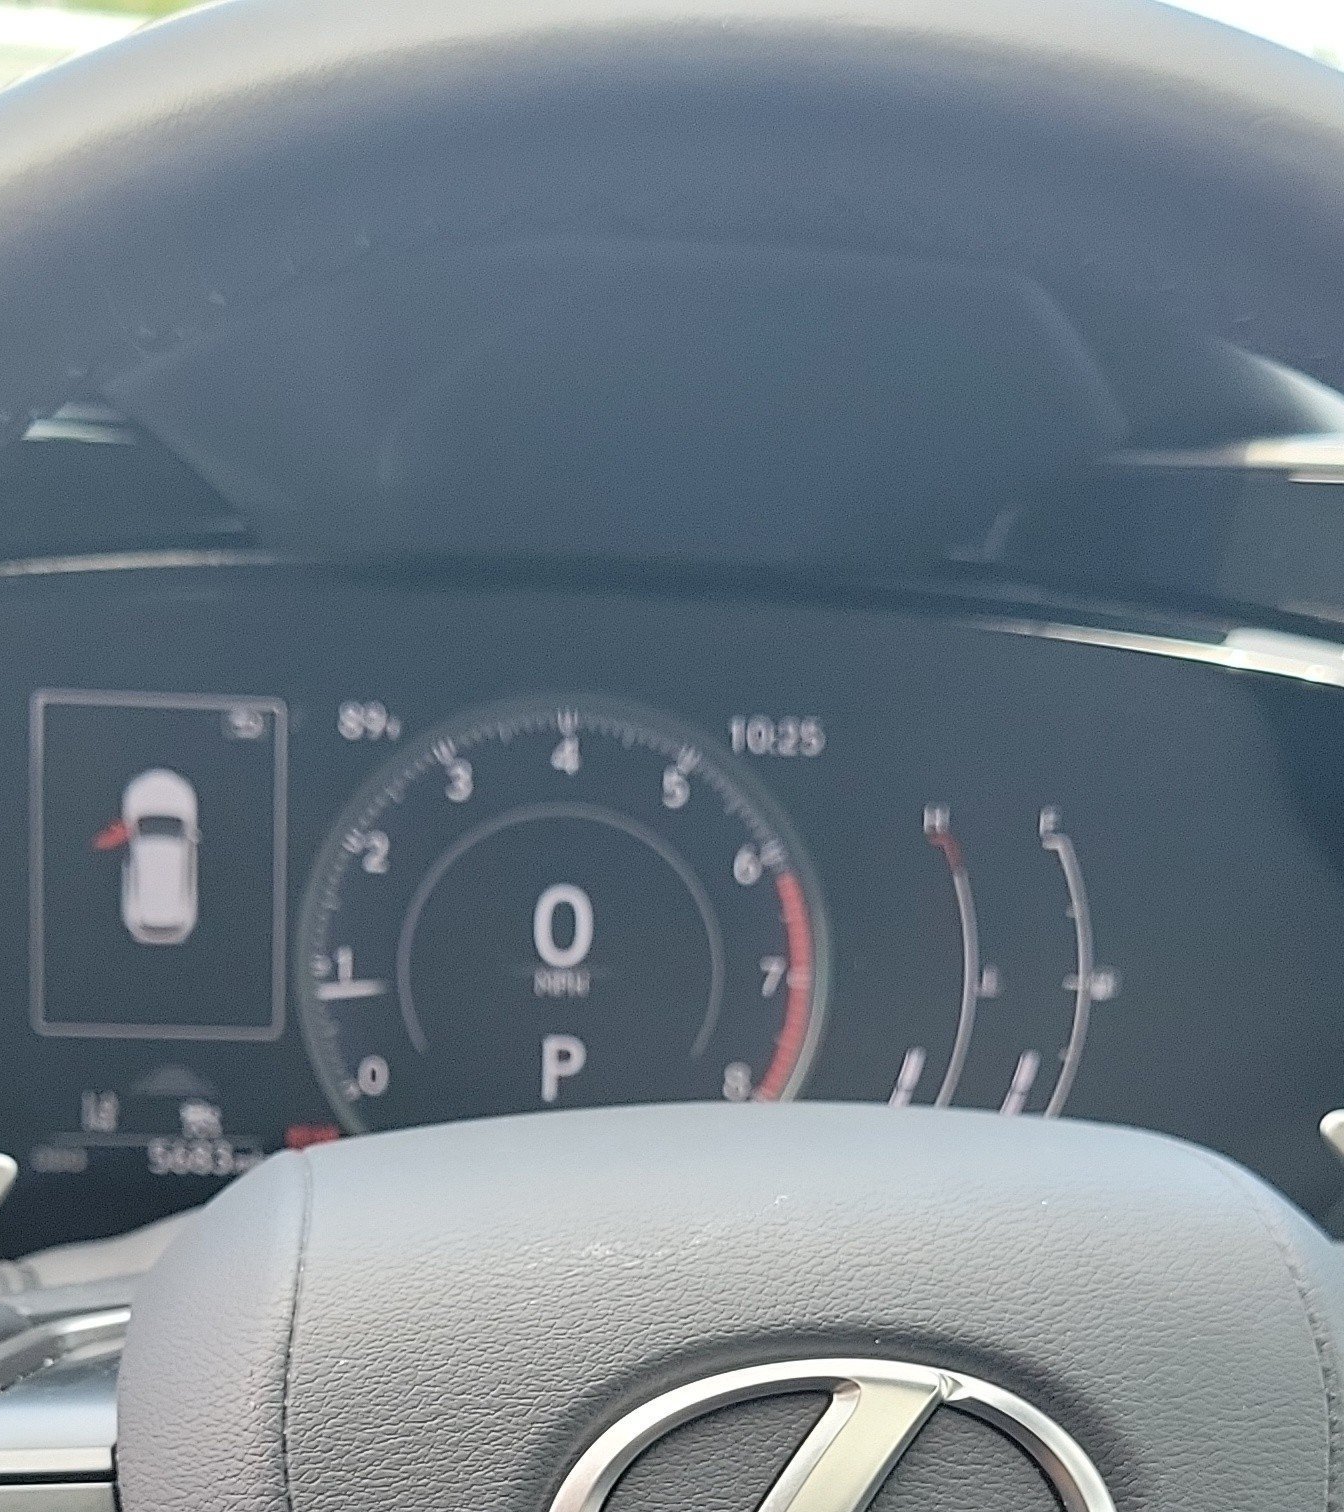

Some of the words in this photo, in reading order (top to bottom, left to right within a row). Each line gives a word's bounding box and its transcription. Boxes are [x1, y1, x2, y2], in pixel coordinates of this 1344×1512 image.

[551, 736, 580, 774] 4
[445, 758, 473, 802] 3
[662, 766, 689, 808] 5
[362, 830, 390, 873] 2
[734, 842, 762, 885] 6
[760, 956, 786, 996] 7
[542, 1034, 587, 1101] P
[724, 1061, 752, 1101] 8
